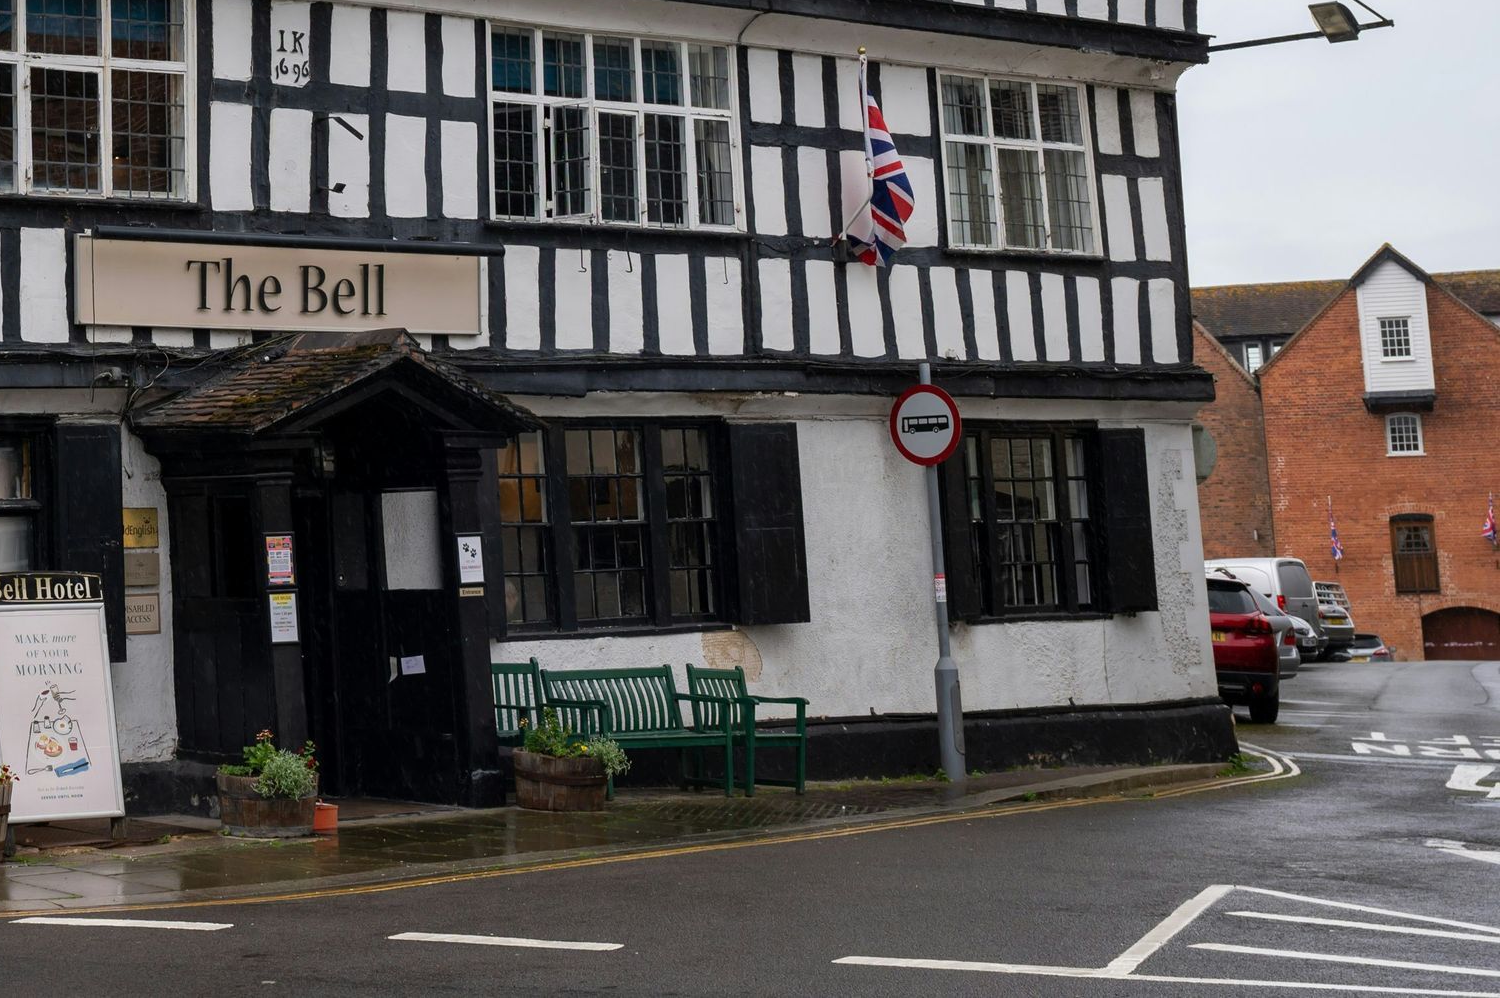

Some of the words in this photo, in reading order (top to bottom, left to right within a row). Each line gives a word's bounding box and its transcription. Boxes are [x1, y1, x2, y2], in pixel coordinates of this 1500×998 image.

[187, 258, 282, 312] The
[299, 263, 387, 316] Bell
[124, 524, 155, 538] dEnglish
[34, 576, 92, 600] Hotel
[124, 604, 155, 614] ISABLED
[14, 633, 49, 644] MAKE
[52, 634, 77, 643] more
[26, 649, 40, 658] OF
[42, 649, 69, 658] YOUR
[15, 662, 83, 676] MORNING
